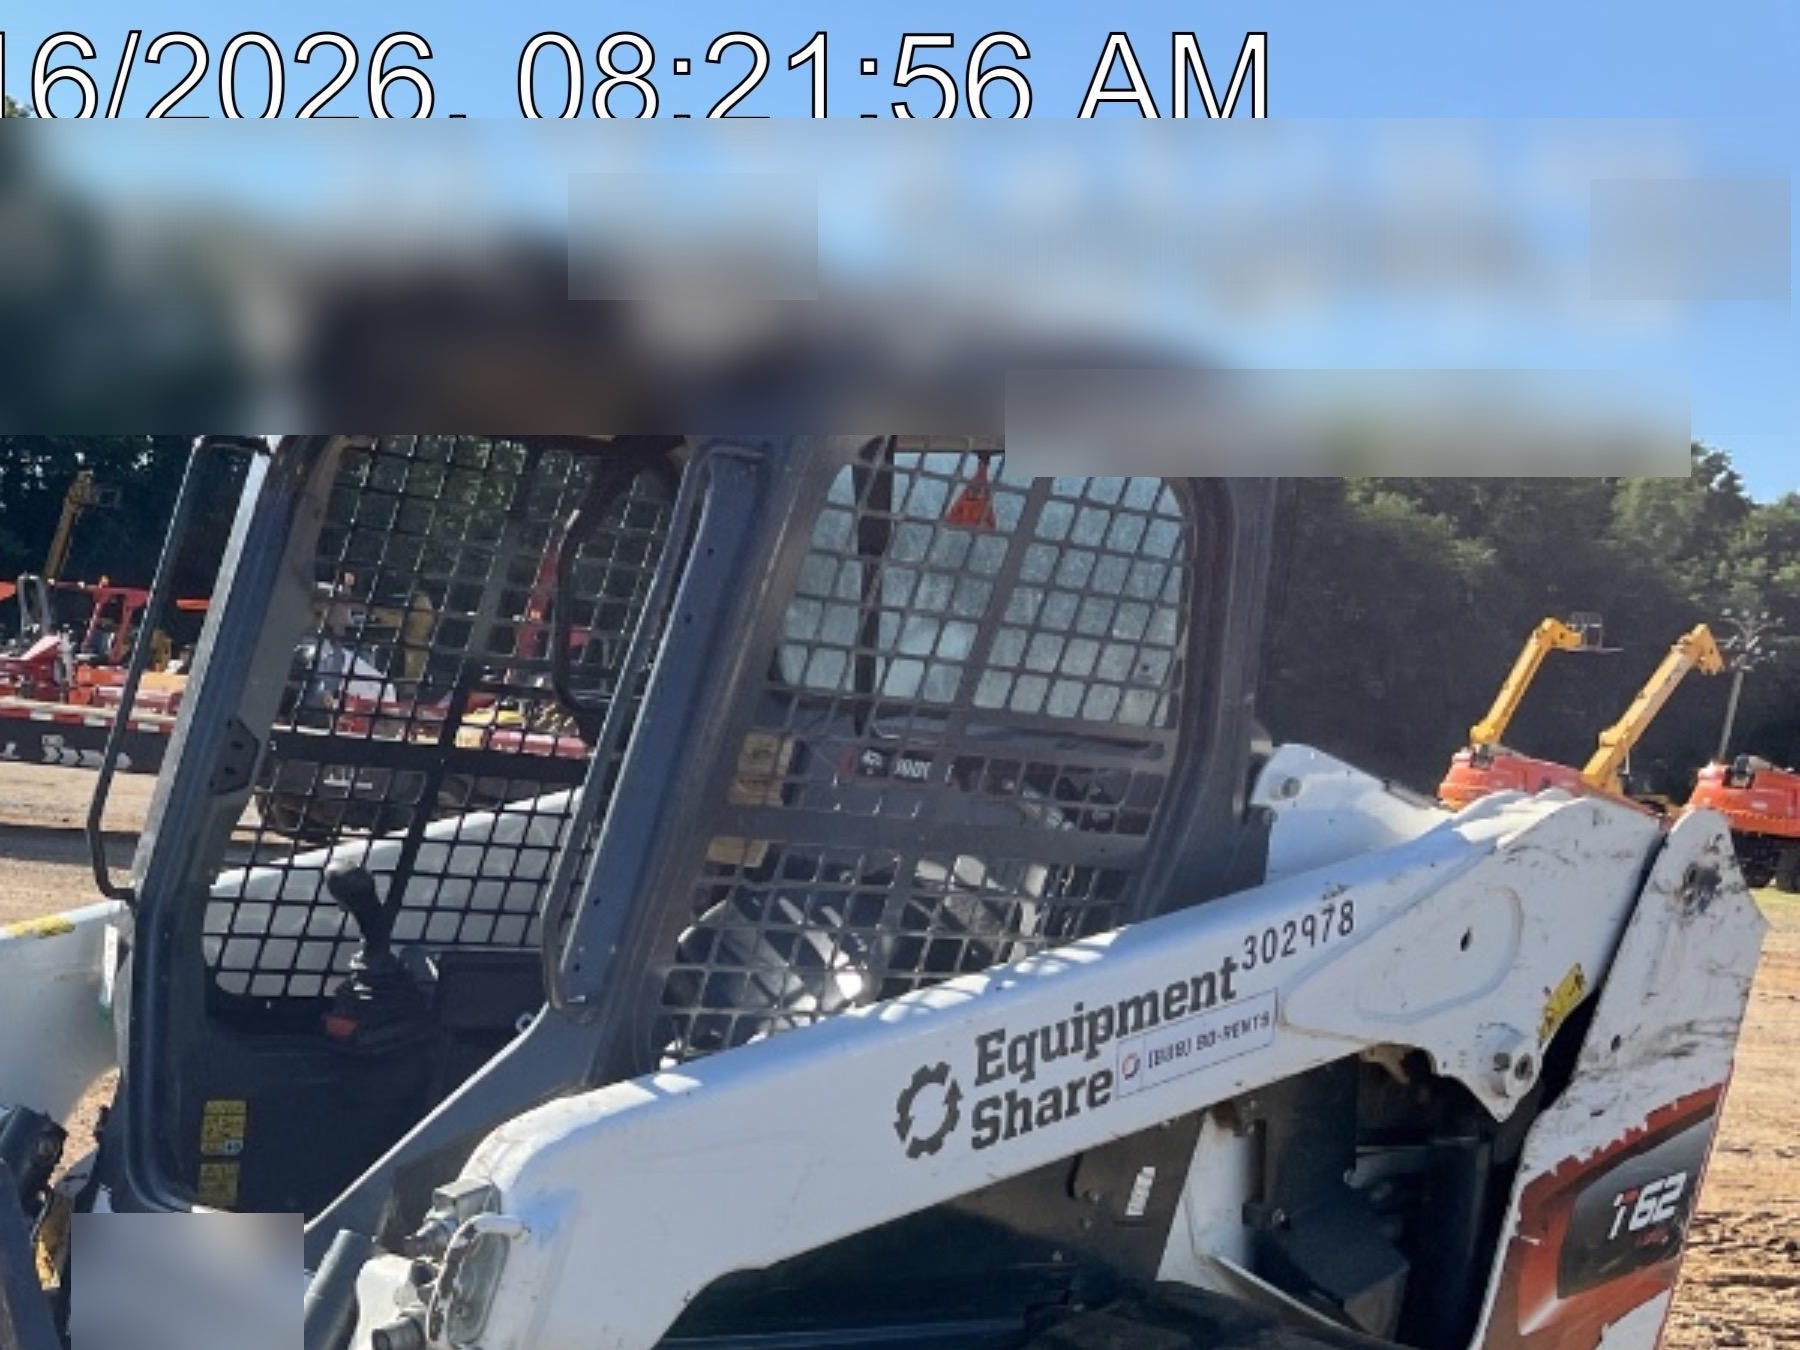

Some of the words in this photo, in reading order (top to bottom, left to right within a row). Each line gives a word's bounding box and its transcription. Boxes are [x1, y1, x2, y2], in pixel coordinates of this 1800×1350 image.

[1240, 899, 1356, 970] 302978
[974, 956, 1239, 1087] Equipment
[970, 1067, 1115, 1151] Share
